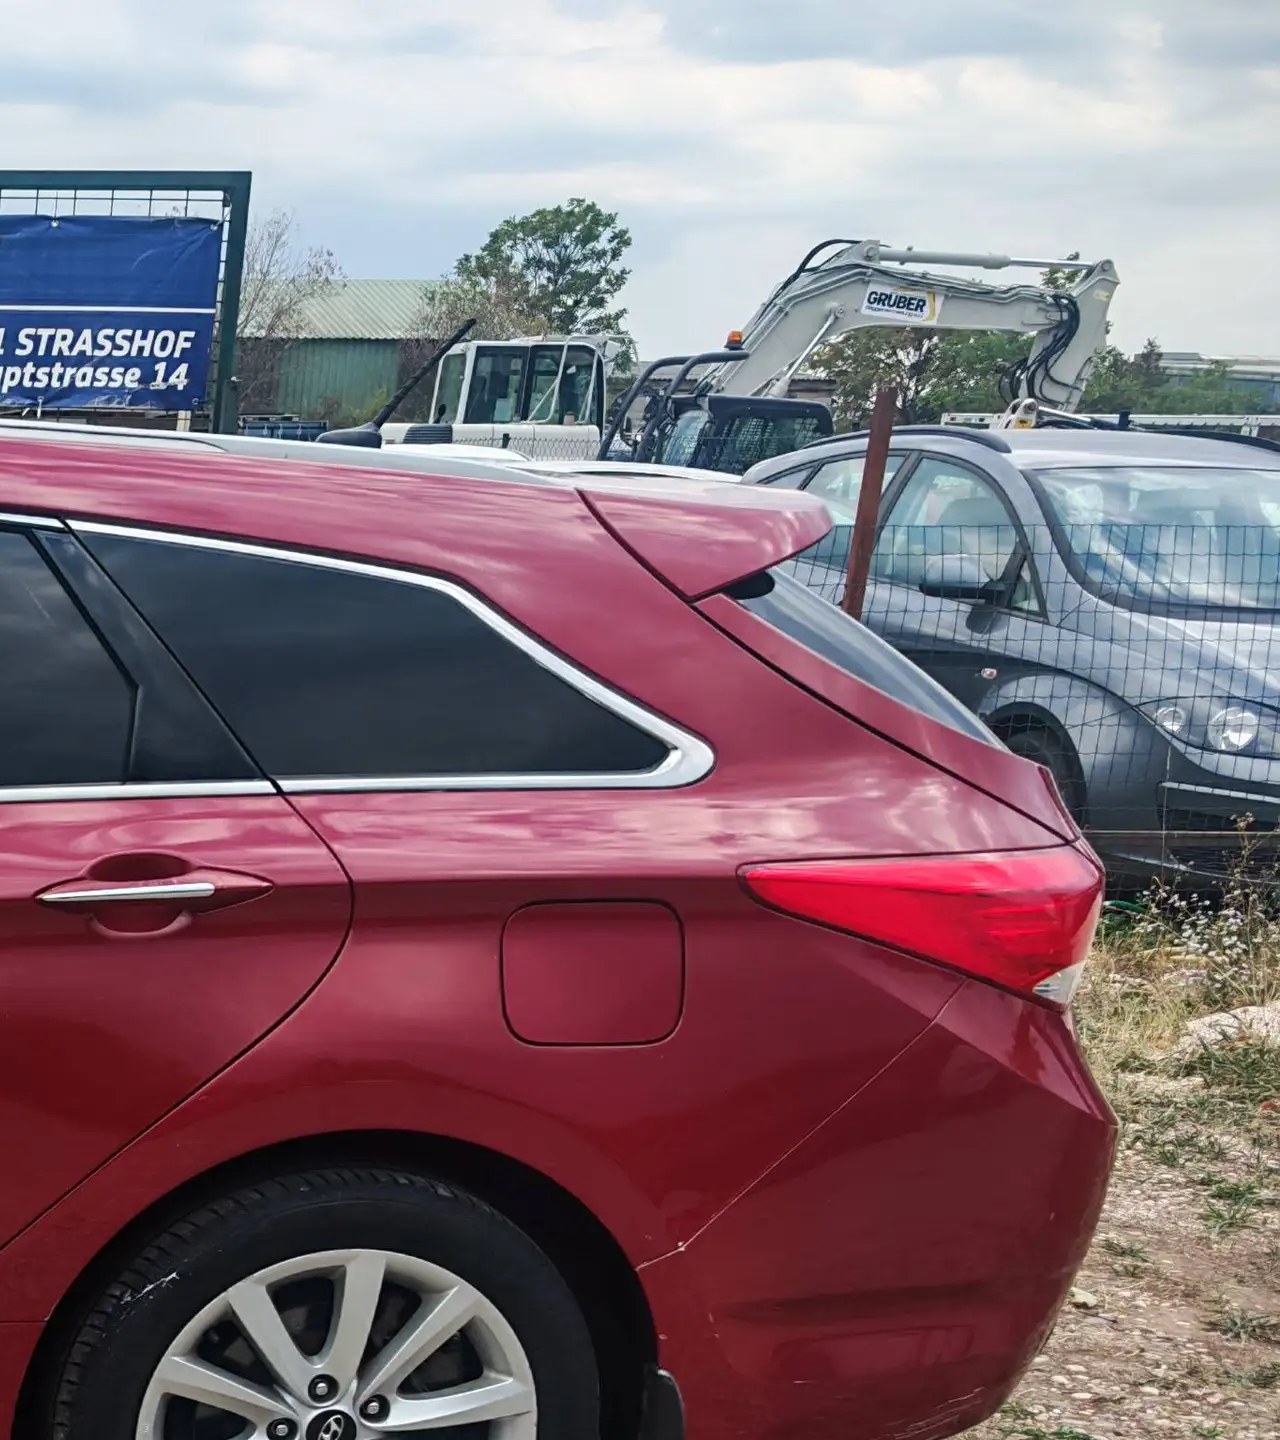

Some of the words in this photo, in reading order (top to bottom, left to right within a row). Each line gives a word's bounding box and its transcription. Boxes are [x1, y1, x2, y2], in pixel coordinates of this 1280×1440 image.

[867, 291, 927, 313] GRUBER
[14, 327, 196, 358] STRASSHOF
[149, 361, 189, 391] 14
